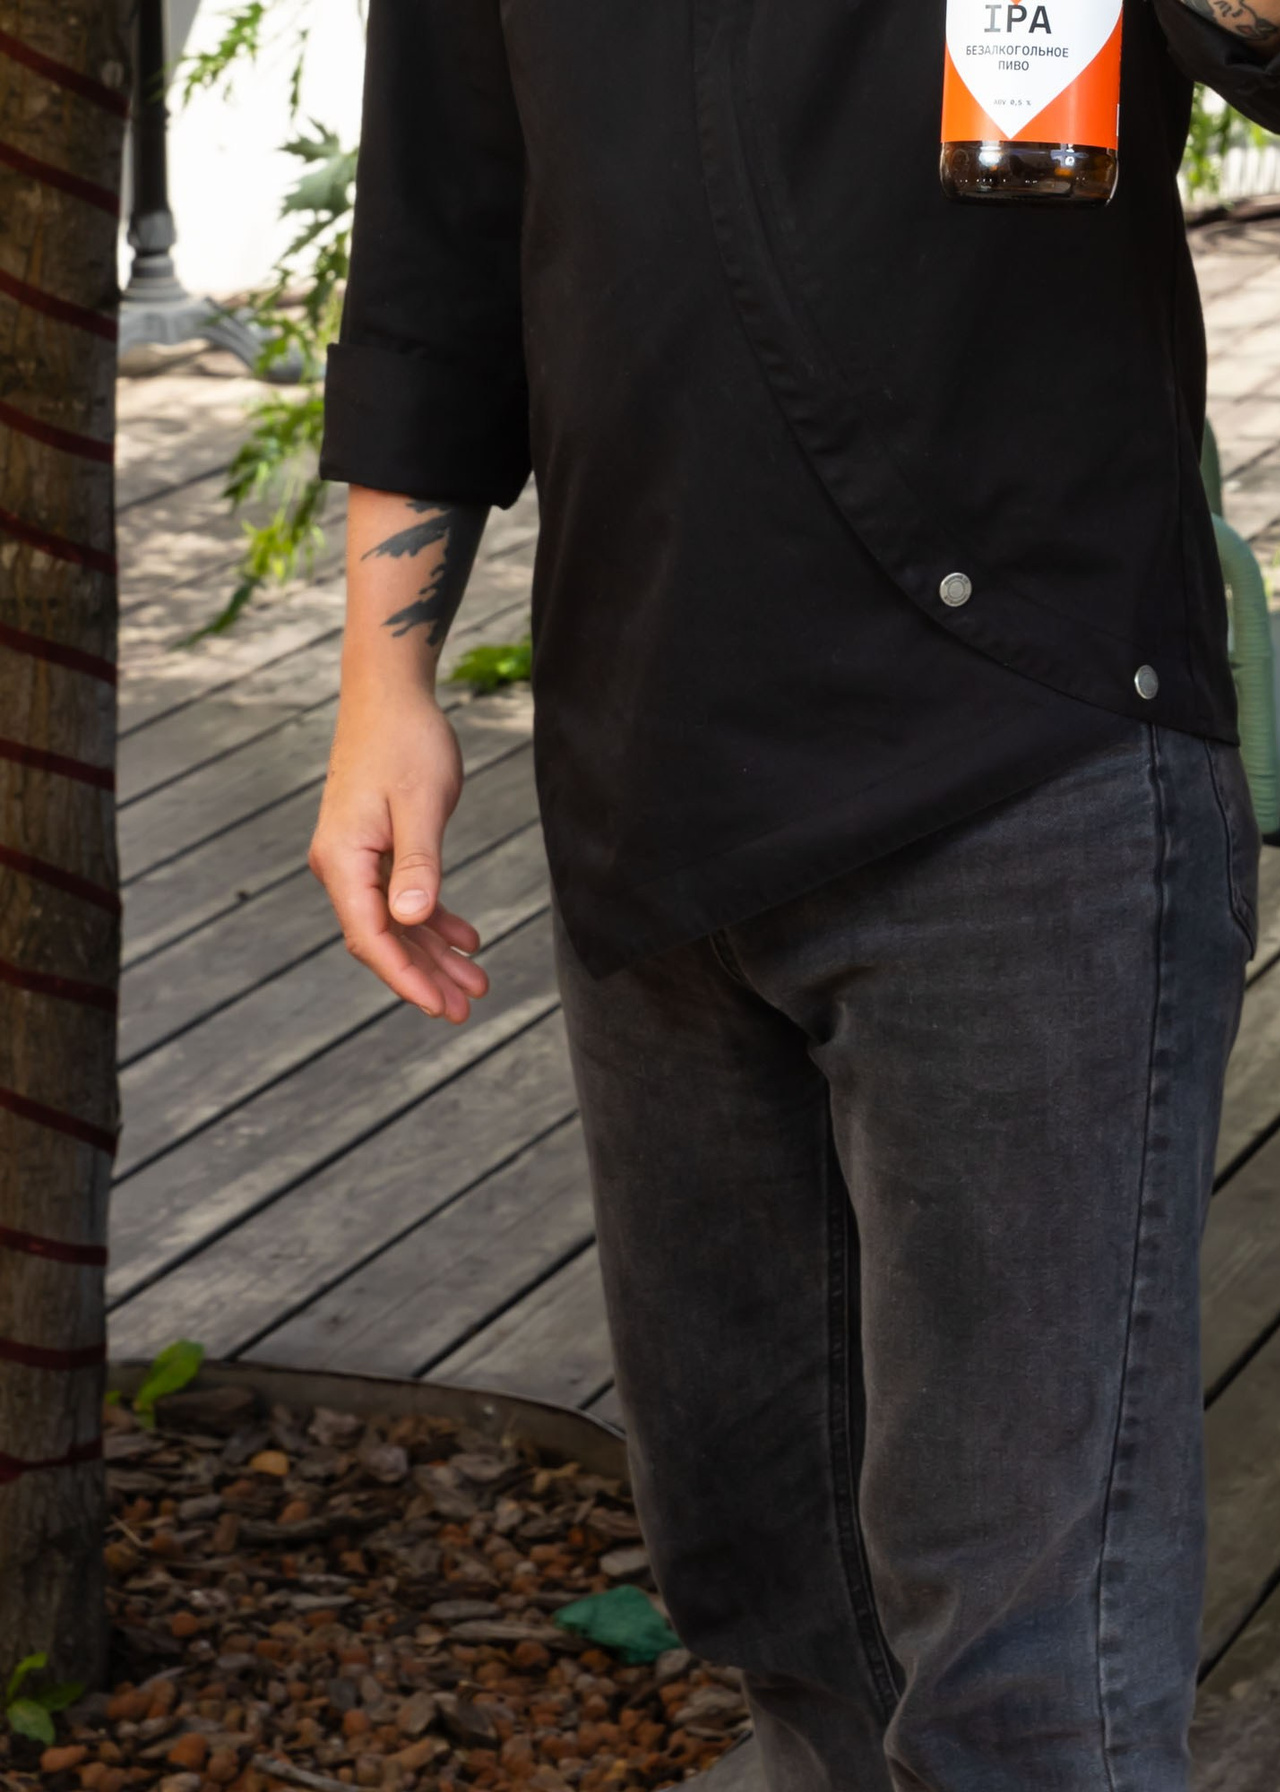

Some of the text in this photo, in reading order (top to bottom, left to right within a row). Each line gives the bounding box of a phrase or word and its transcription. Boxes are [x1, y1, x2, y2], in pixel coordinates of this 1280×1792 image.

[984, 4, 1052, 34] IPA
[966, 45, 1069, 58] БЕЗАЛКОГОЛЬНОЕ
[998, 60, 1030, 71] ПИВО
